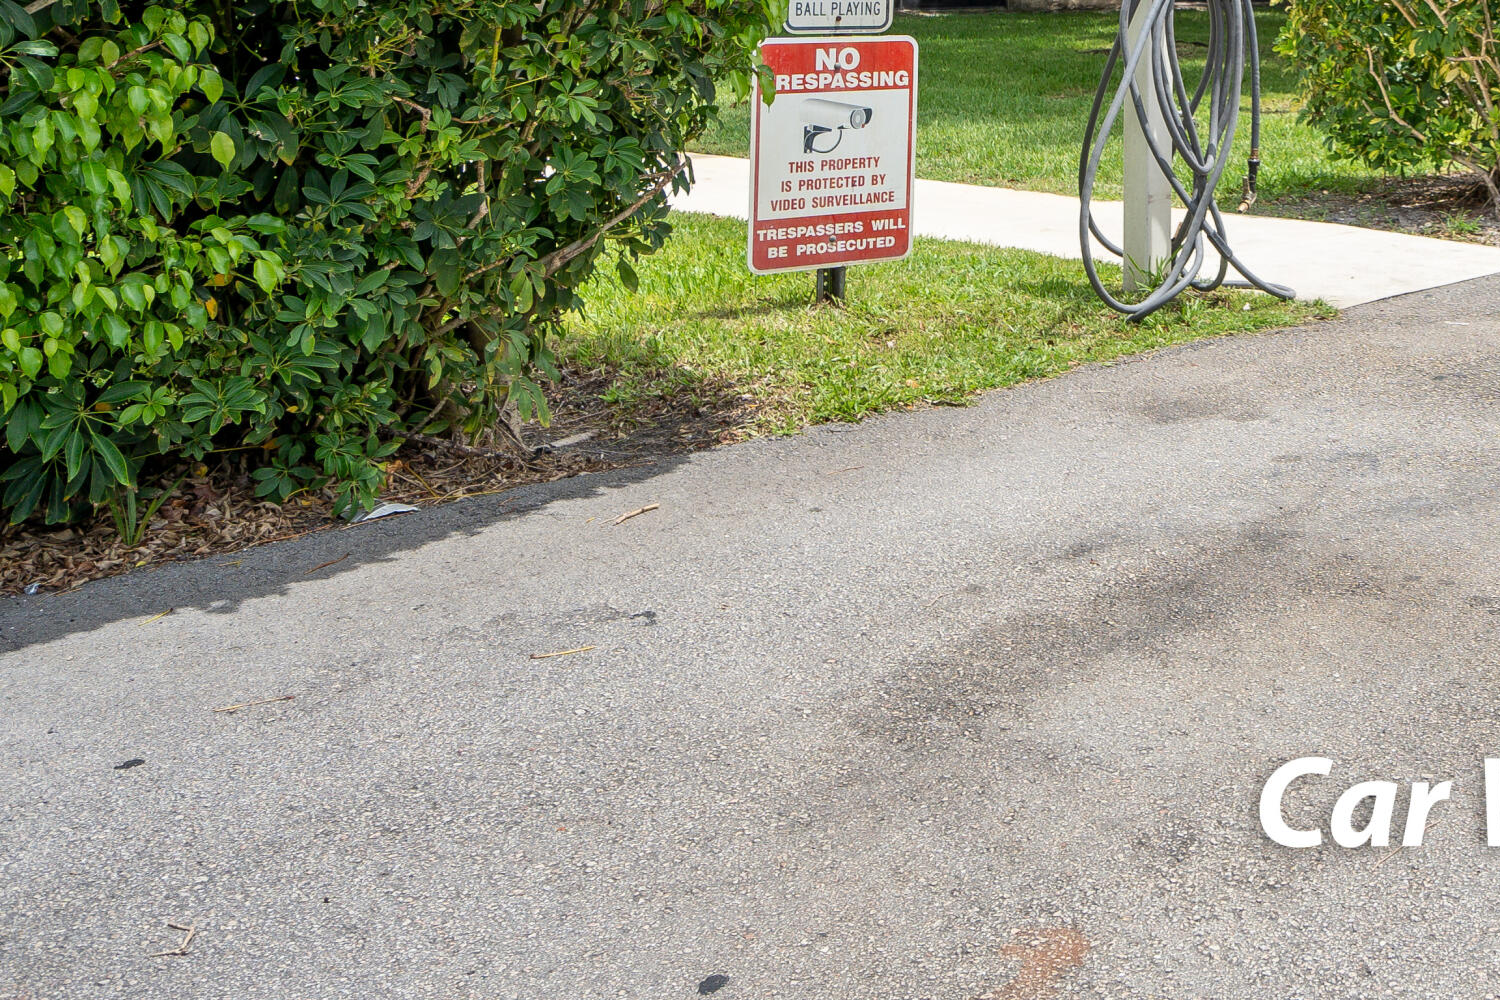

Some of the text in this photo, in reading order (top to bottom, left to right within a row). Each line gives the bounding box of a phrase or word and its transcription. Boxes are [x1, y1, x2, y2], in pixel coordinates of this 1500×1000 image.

[795, 1, 881, 16] BALL PLAYING
[815, 47, 861, 71] NO
[775, 70, 909, 91] RESPASSING
[788, 156, 880, 174] THIS PROPERTY
[781, 174, 886, 193] IS PROTECTED BY
[770, 191, 895, 212] VIDEO SURVEILLANCE
[757, 218, 906, 242] TRESPASSERS WILL
[767, 236, 895, 259] BE PROSECUTED
